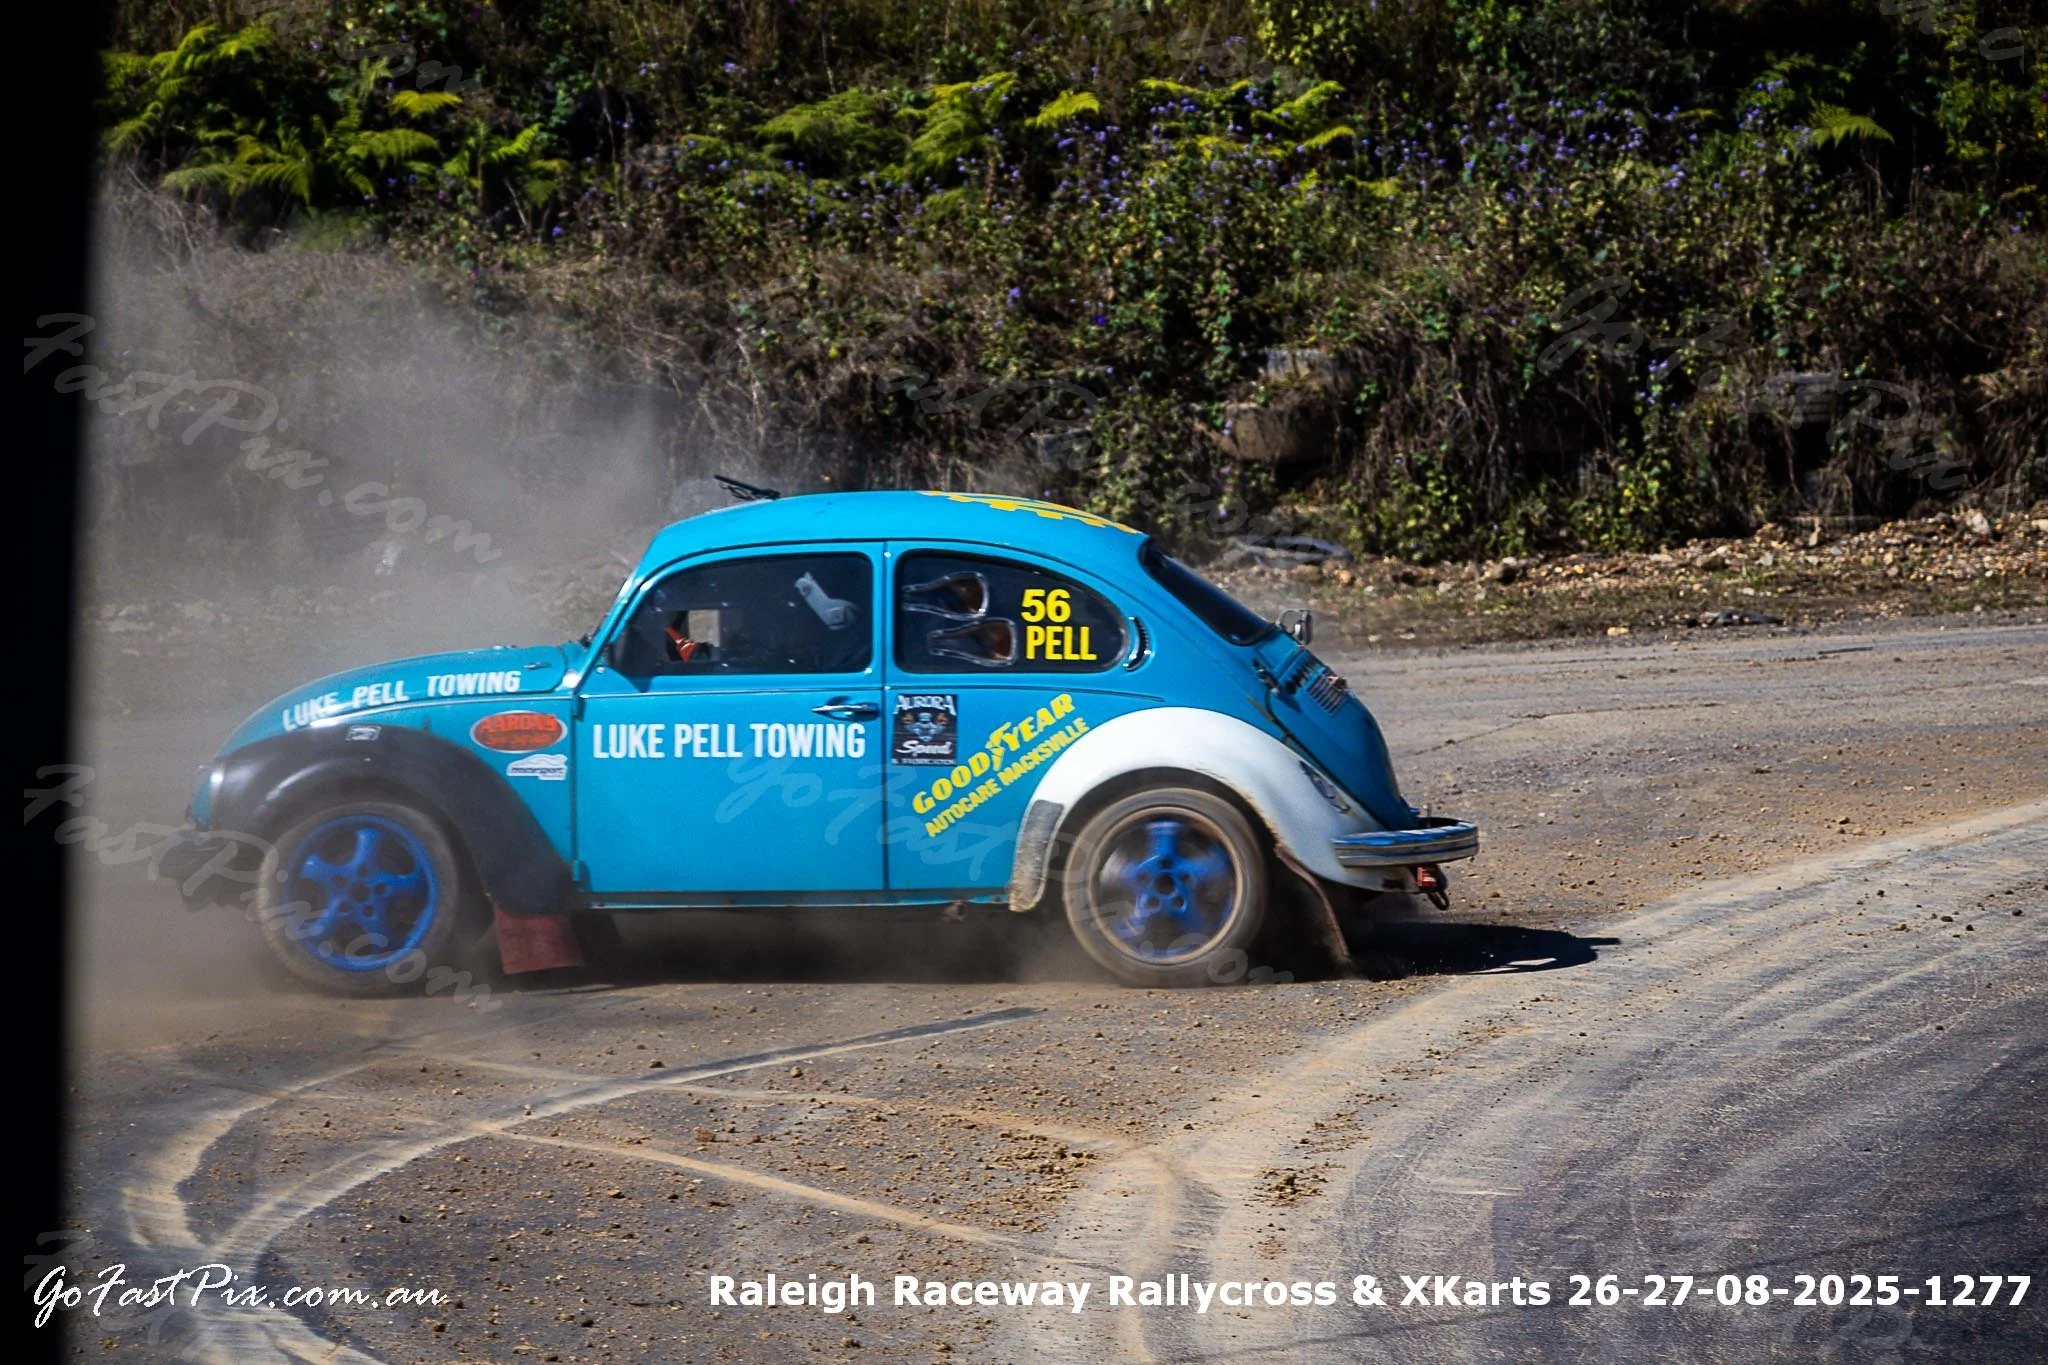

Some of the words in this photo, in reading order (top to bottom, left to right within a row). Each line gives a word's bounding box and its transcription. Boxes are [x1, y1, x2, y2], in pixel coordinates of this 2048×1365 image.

[1021, 589, 1071, 623] 56
[1026, 625, 1097, 661] PELL
[282, 691, 339, 732] LUKE
[350, 680, 409, 709] PELL
[426, 670, 521, 697] TOWING
[592, 723, 665, 758] LUKE
[674, 723, 743, 758] PELL
[749, 723, 866, 758] TOWING
[925, 778, 1002, 838] AUTOCARE
[997, 717, 1090, 786] MACKSVILLE
